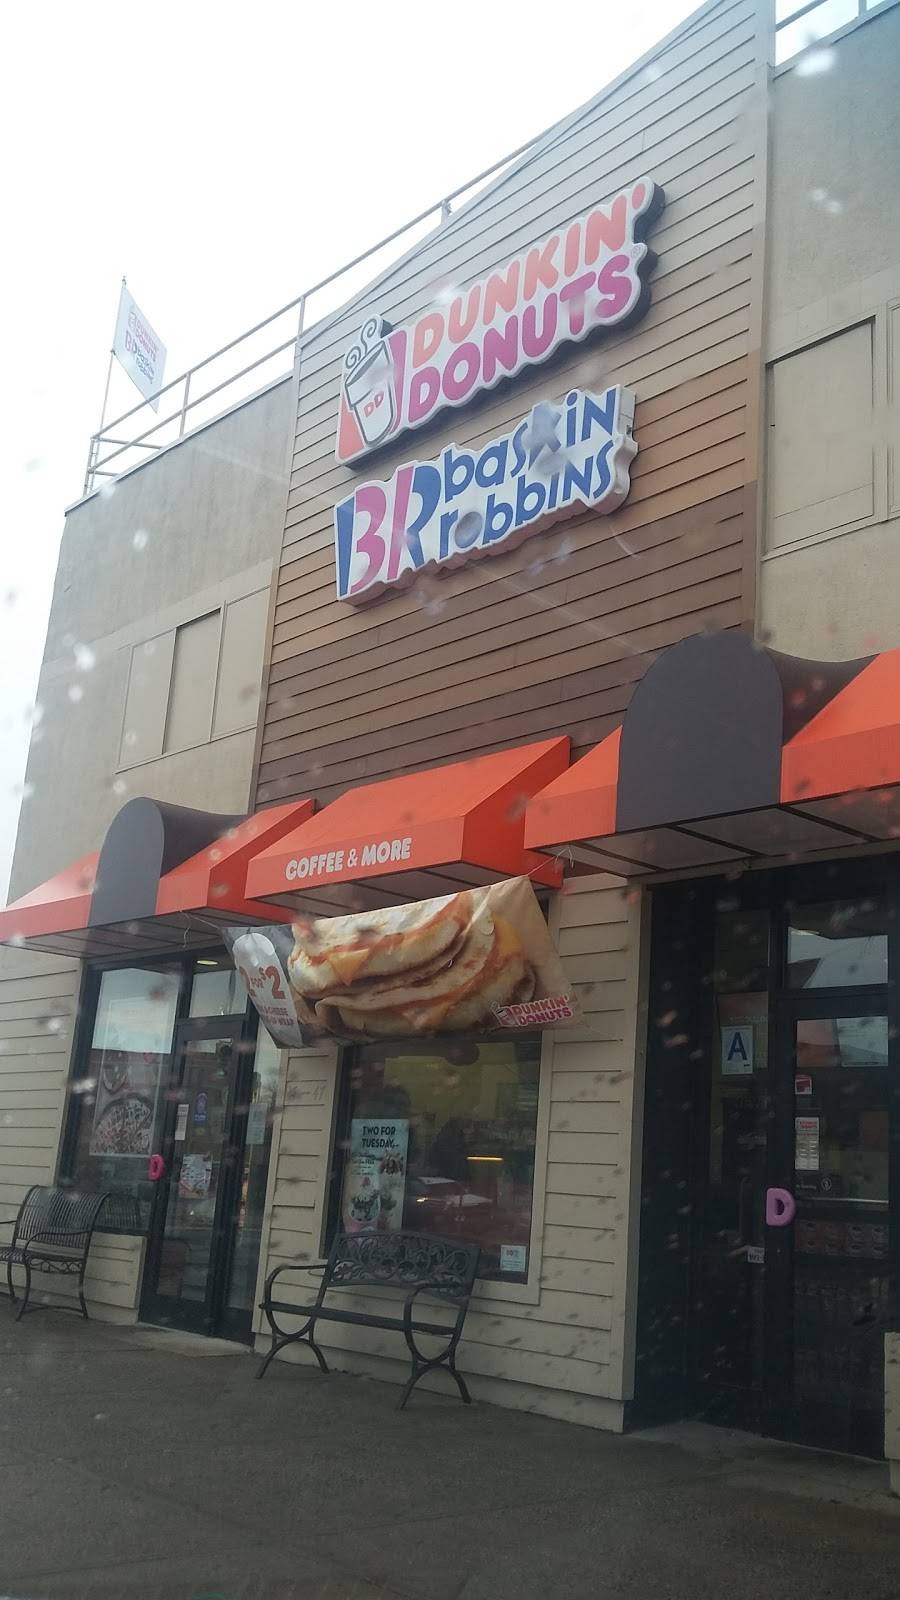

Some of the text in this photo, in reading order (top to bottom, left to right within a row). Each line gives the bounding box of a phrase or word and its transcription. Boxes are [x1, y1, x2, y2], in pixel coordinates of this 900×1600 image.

[412, 183, 647, 368] DUNKIN'
[408, 254, 632, 423] DONUTS
[336, 465, 442, 596] BR
[285, 837, 412, 880] COFFEE & MORE
[511, 994, 569, 1015] DUNKIN'
[518, 1006, 572, 1026] DONUTS
[727, 1031, 747, 1061] A
[362, 1126, 396, 1137] TWO FOR
[766, 1187, 796, 1227] D
